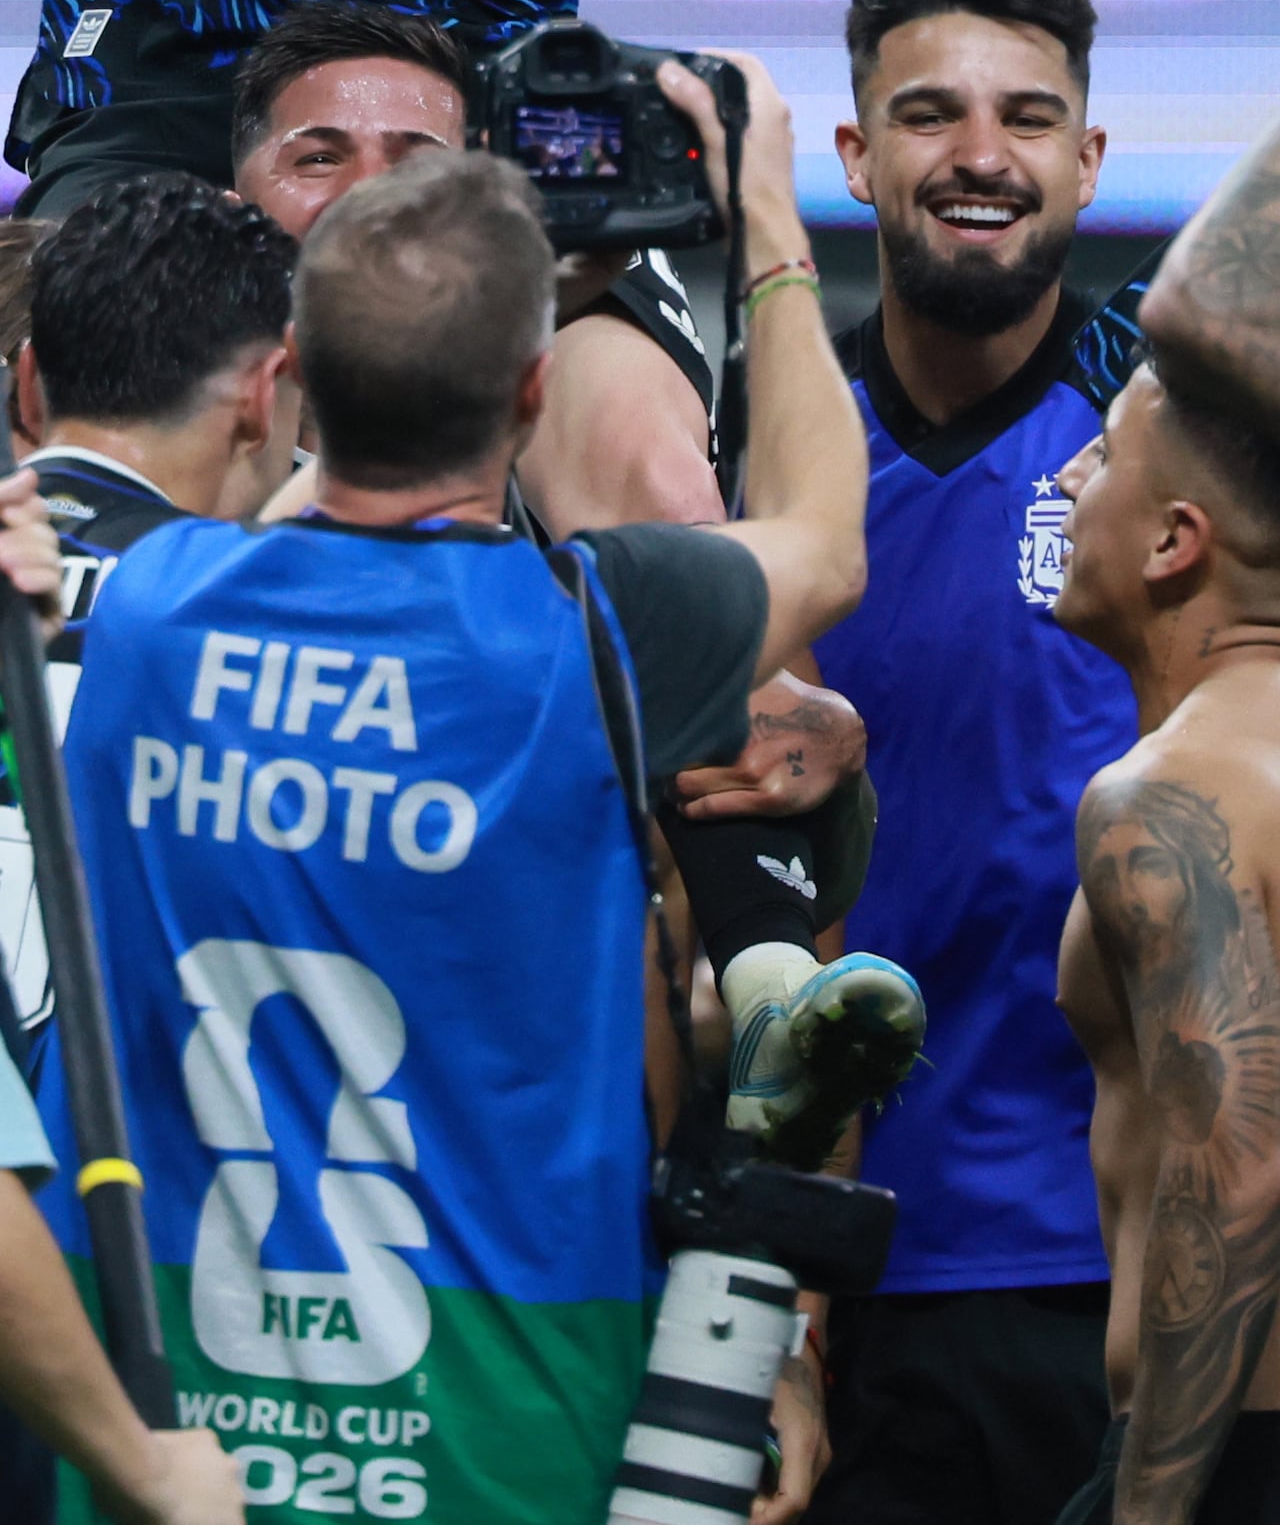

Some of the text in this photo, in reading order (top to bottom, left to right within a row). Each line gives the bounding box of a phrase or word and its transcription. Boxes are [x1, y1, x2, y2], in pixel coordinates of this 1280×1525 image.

[190, 630, 418, 753] FIFA
[129, 734, 479, 875] PHOTO
[262, 1289, 362, 1344] FIFA
[176, 1390, 432, 1447] WORLD CUP
[230, 1443, 429, 1520] 026
